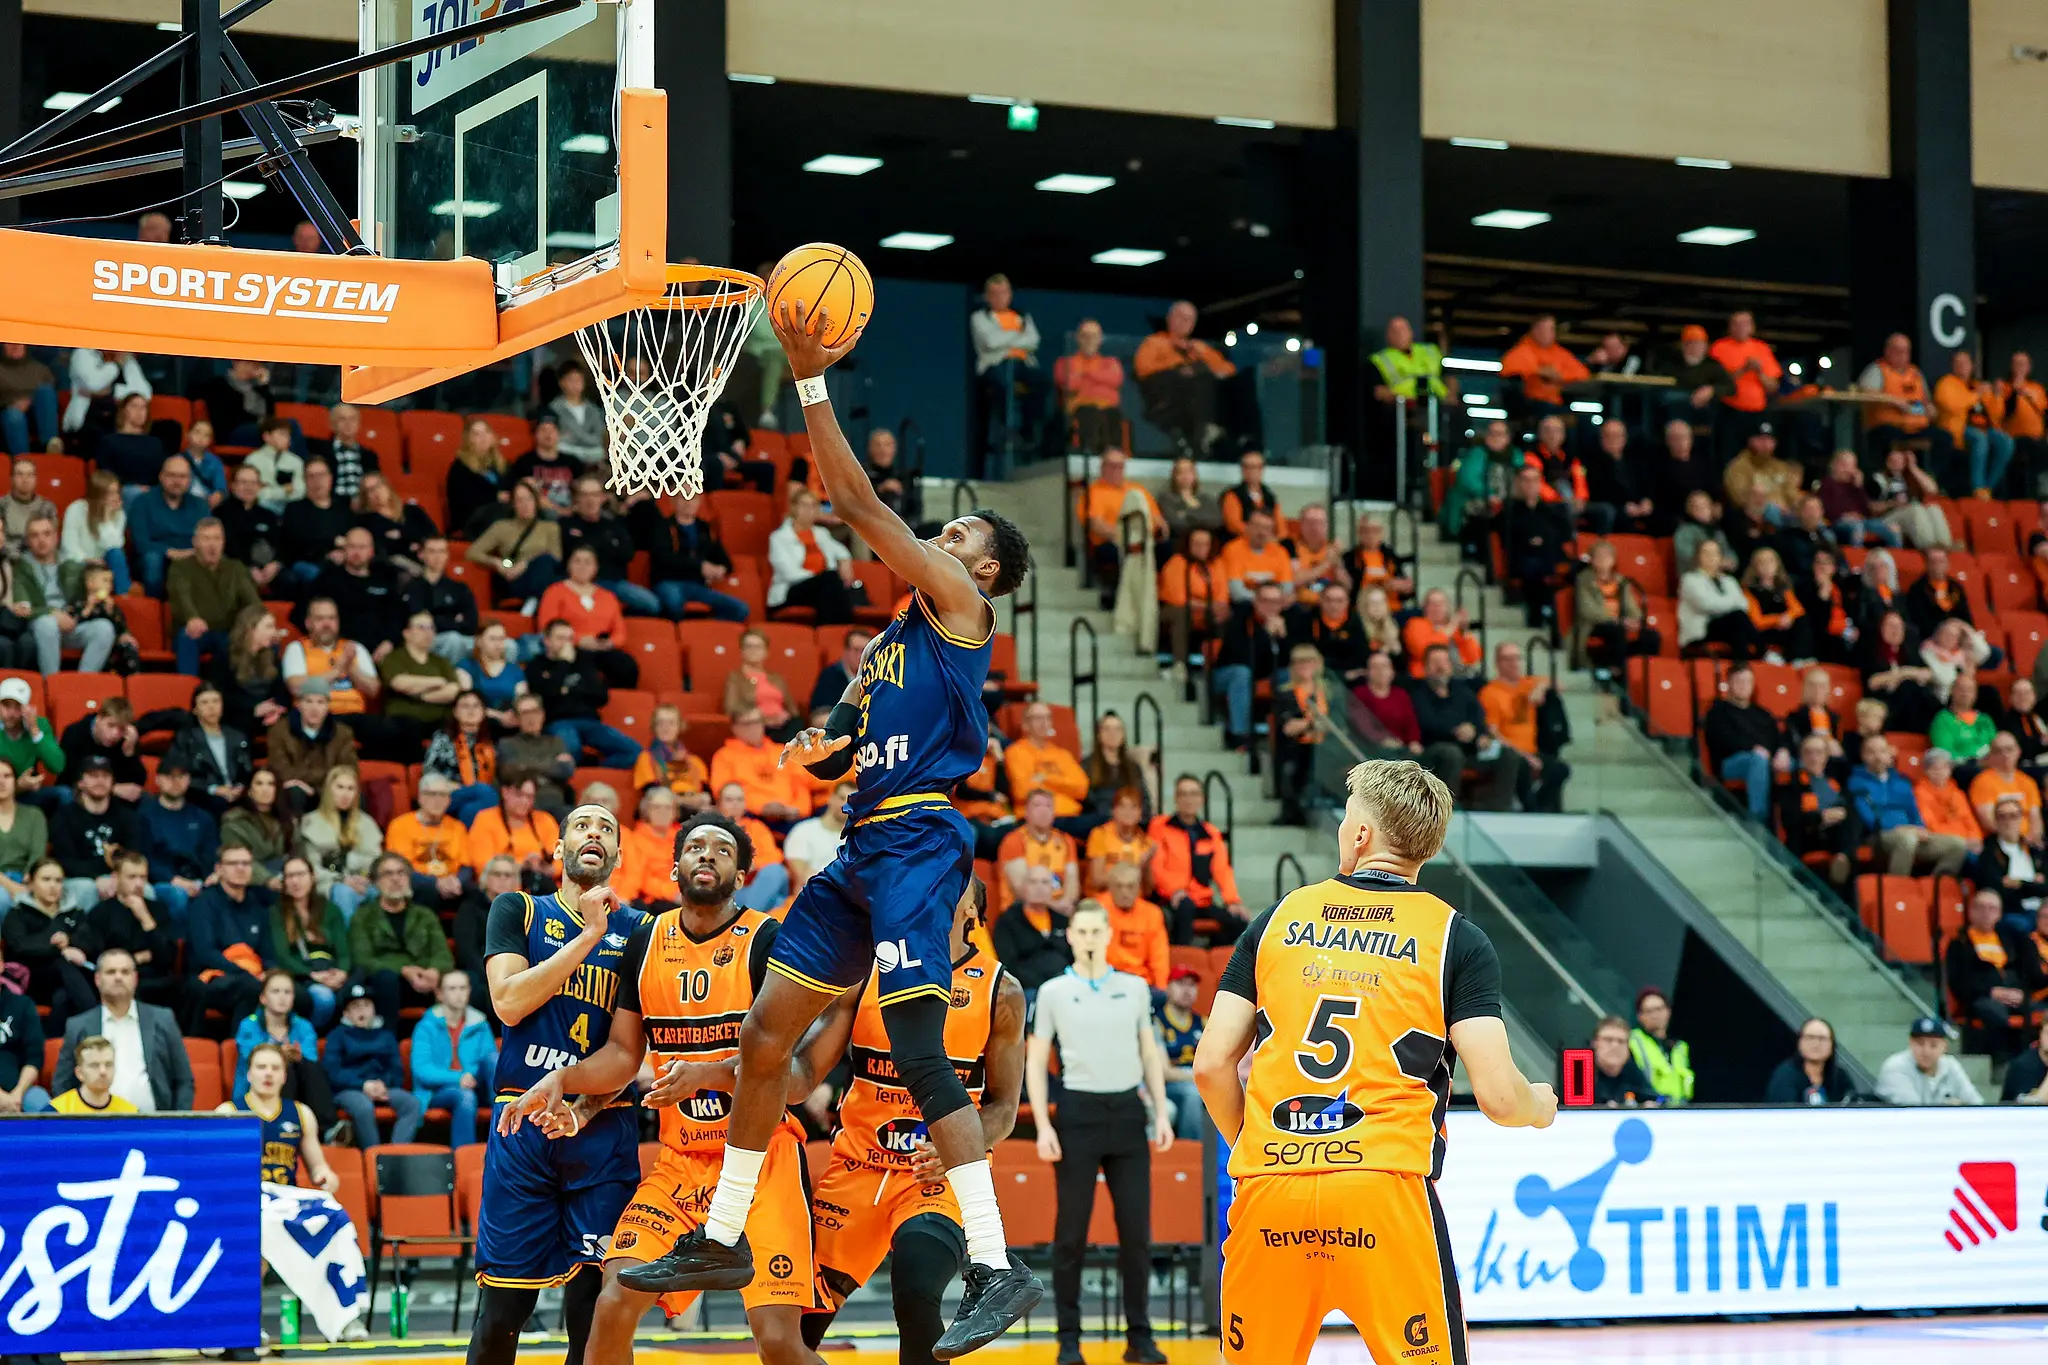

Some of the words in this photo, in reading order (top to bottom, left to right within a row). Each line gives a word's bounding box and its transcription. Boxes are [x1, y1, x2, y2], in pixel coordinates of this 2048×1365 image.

[93, 259, 232, 300] SPORT
[233, 273, 400, 314] SYSTEM
[1930, 293, 1966, 348] C
[1368, 870, 1390, 880] JAKO
[1283, 920, 1418, 965] SAJANTILA
[676, 968, 711, 1003] 10
[569, 1012, 590, 1054] 4
[652, 1021, 741, 1045] KARHUBASKET
[1294, 993, 1362, 1084] 5
[1264, 1140, 1364, 1166] serres
[0, 1148, 224, 1335] sti
[651, 1221, 670, 1236] Oy
[1260, 1226, 1376, 1249] Terveystalo
[1306, 1251, 1335, 1261] SPORT
[1606, 1202, 1839, 1294] TIIMI
[1228, 1312, 1244, 1351] 5
[1401, 1345, 1440, 1358] GATORADE
